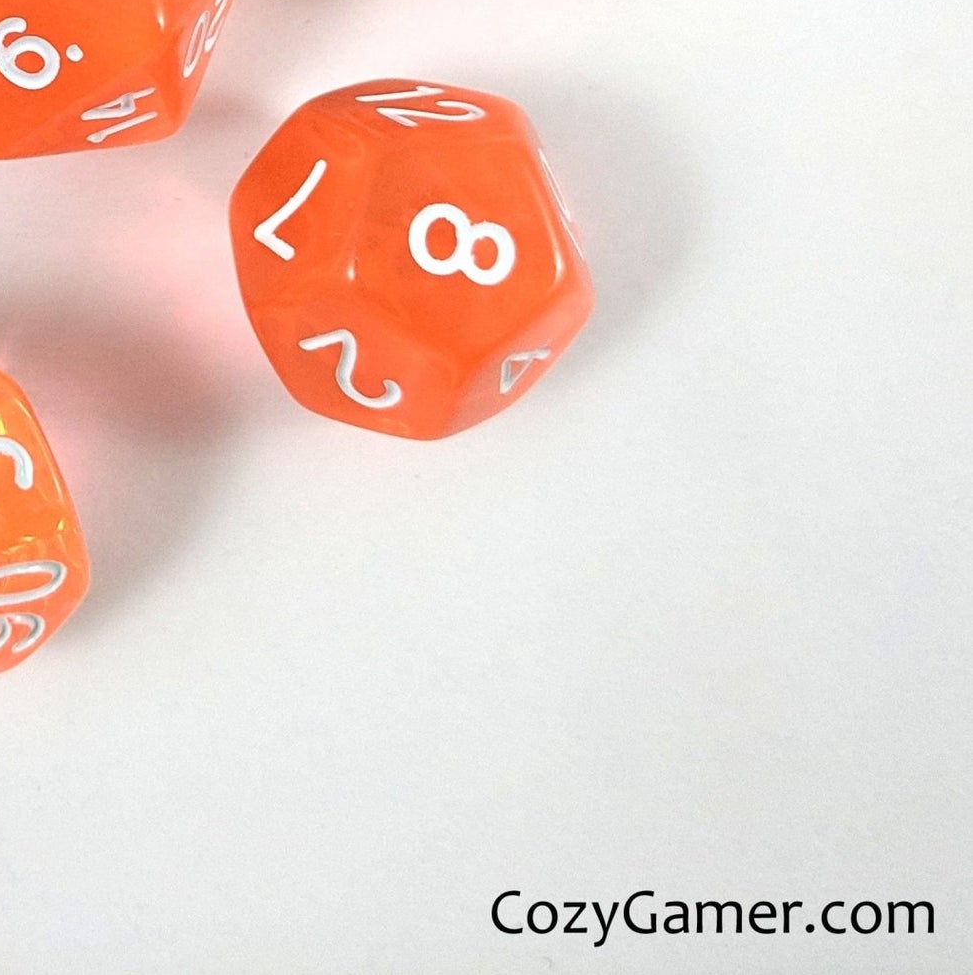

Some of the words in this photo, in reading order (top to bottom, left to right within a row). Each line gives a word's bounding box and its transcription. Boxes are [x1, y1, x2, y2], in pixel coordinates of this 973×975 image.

[80, 87, 159, 144] 14
[354, 84, 486, 128] 12
[253, 158, 327, 261] 7
[408, 202, 516, 286] 8
[298, 328, 403, 410] 2
[499, 346, 551, 395] 4
